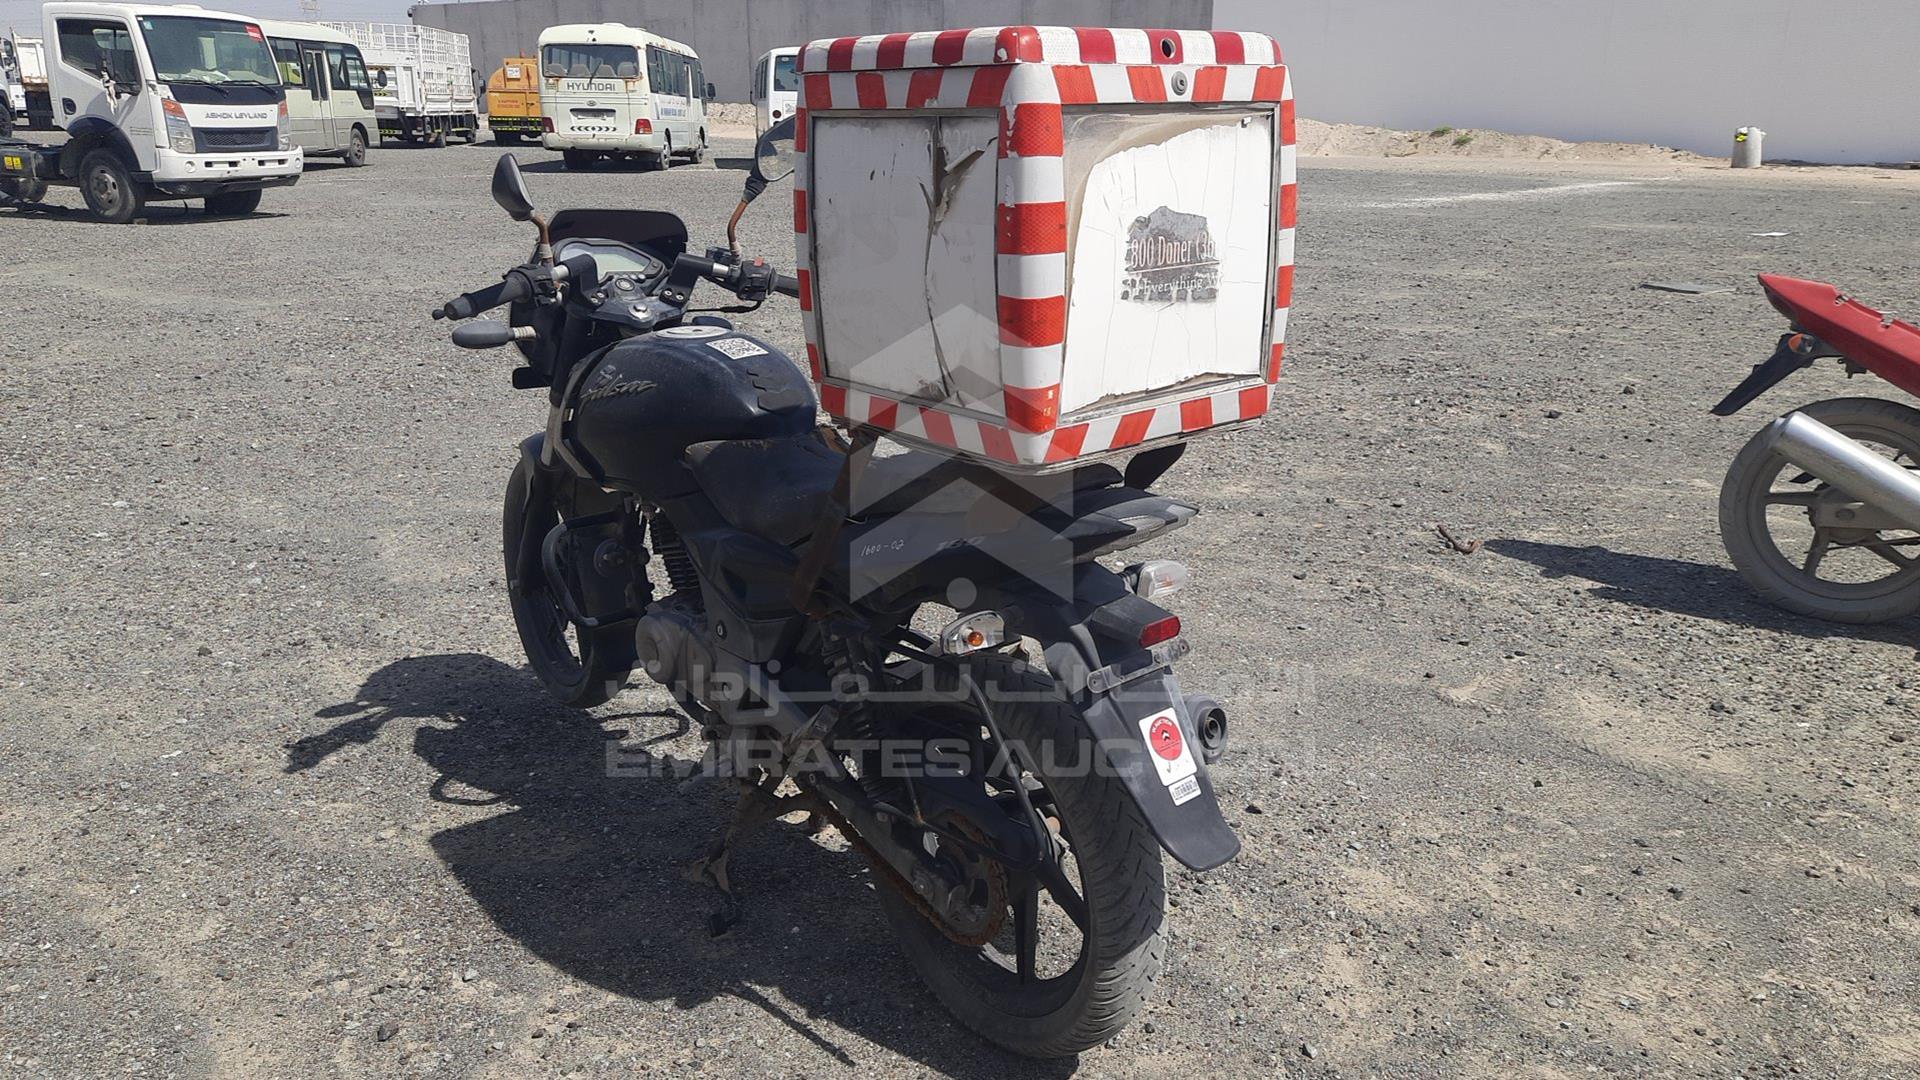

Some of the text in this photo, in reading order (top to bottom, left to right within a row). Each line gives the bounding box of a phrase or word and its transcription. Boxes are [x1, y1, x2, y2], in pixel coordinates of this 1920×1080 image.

[566, 82, 616, 92] HYUNDAI
[1131, 238, 1155, 268] 800
[1157, 236, 1193, 266] Doner
